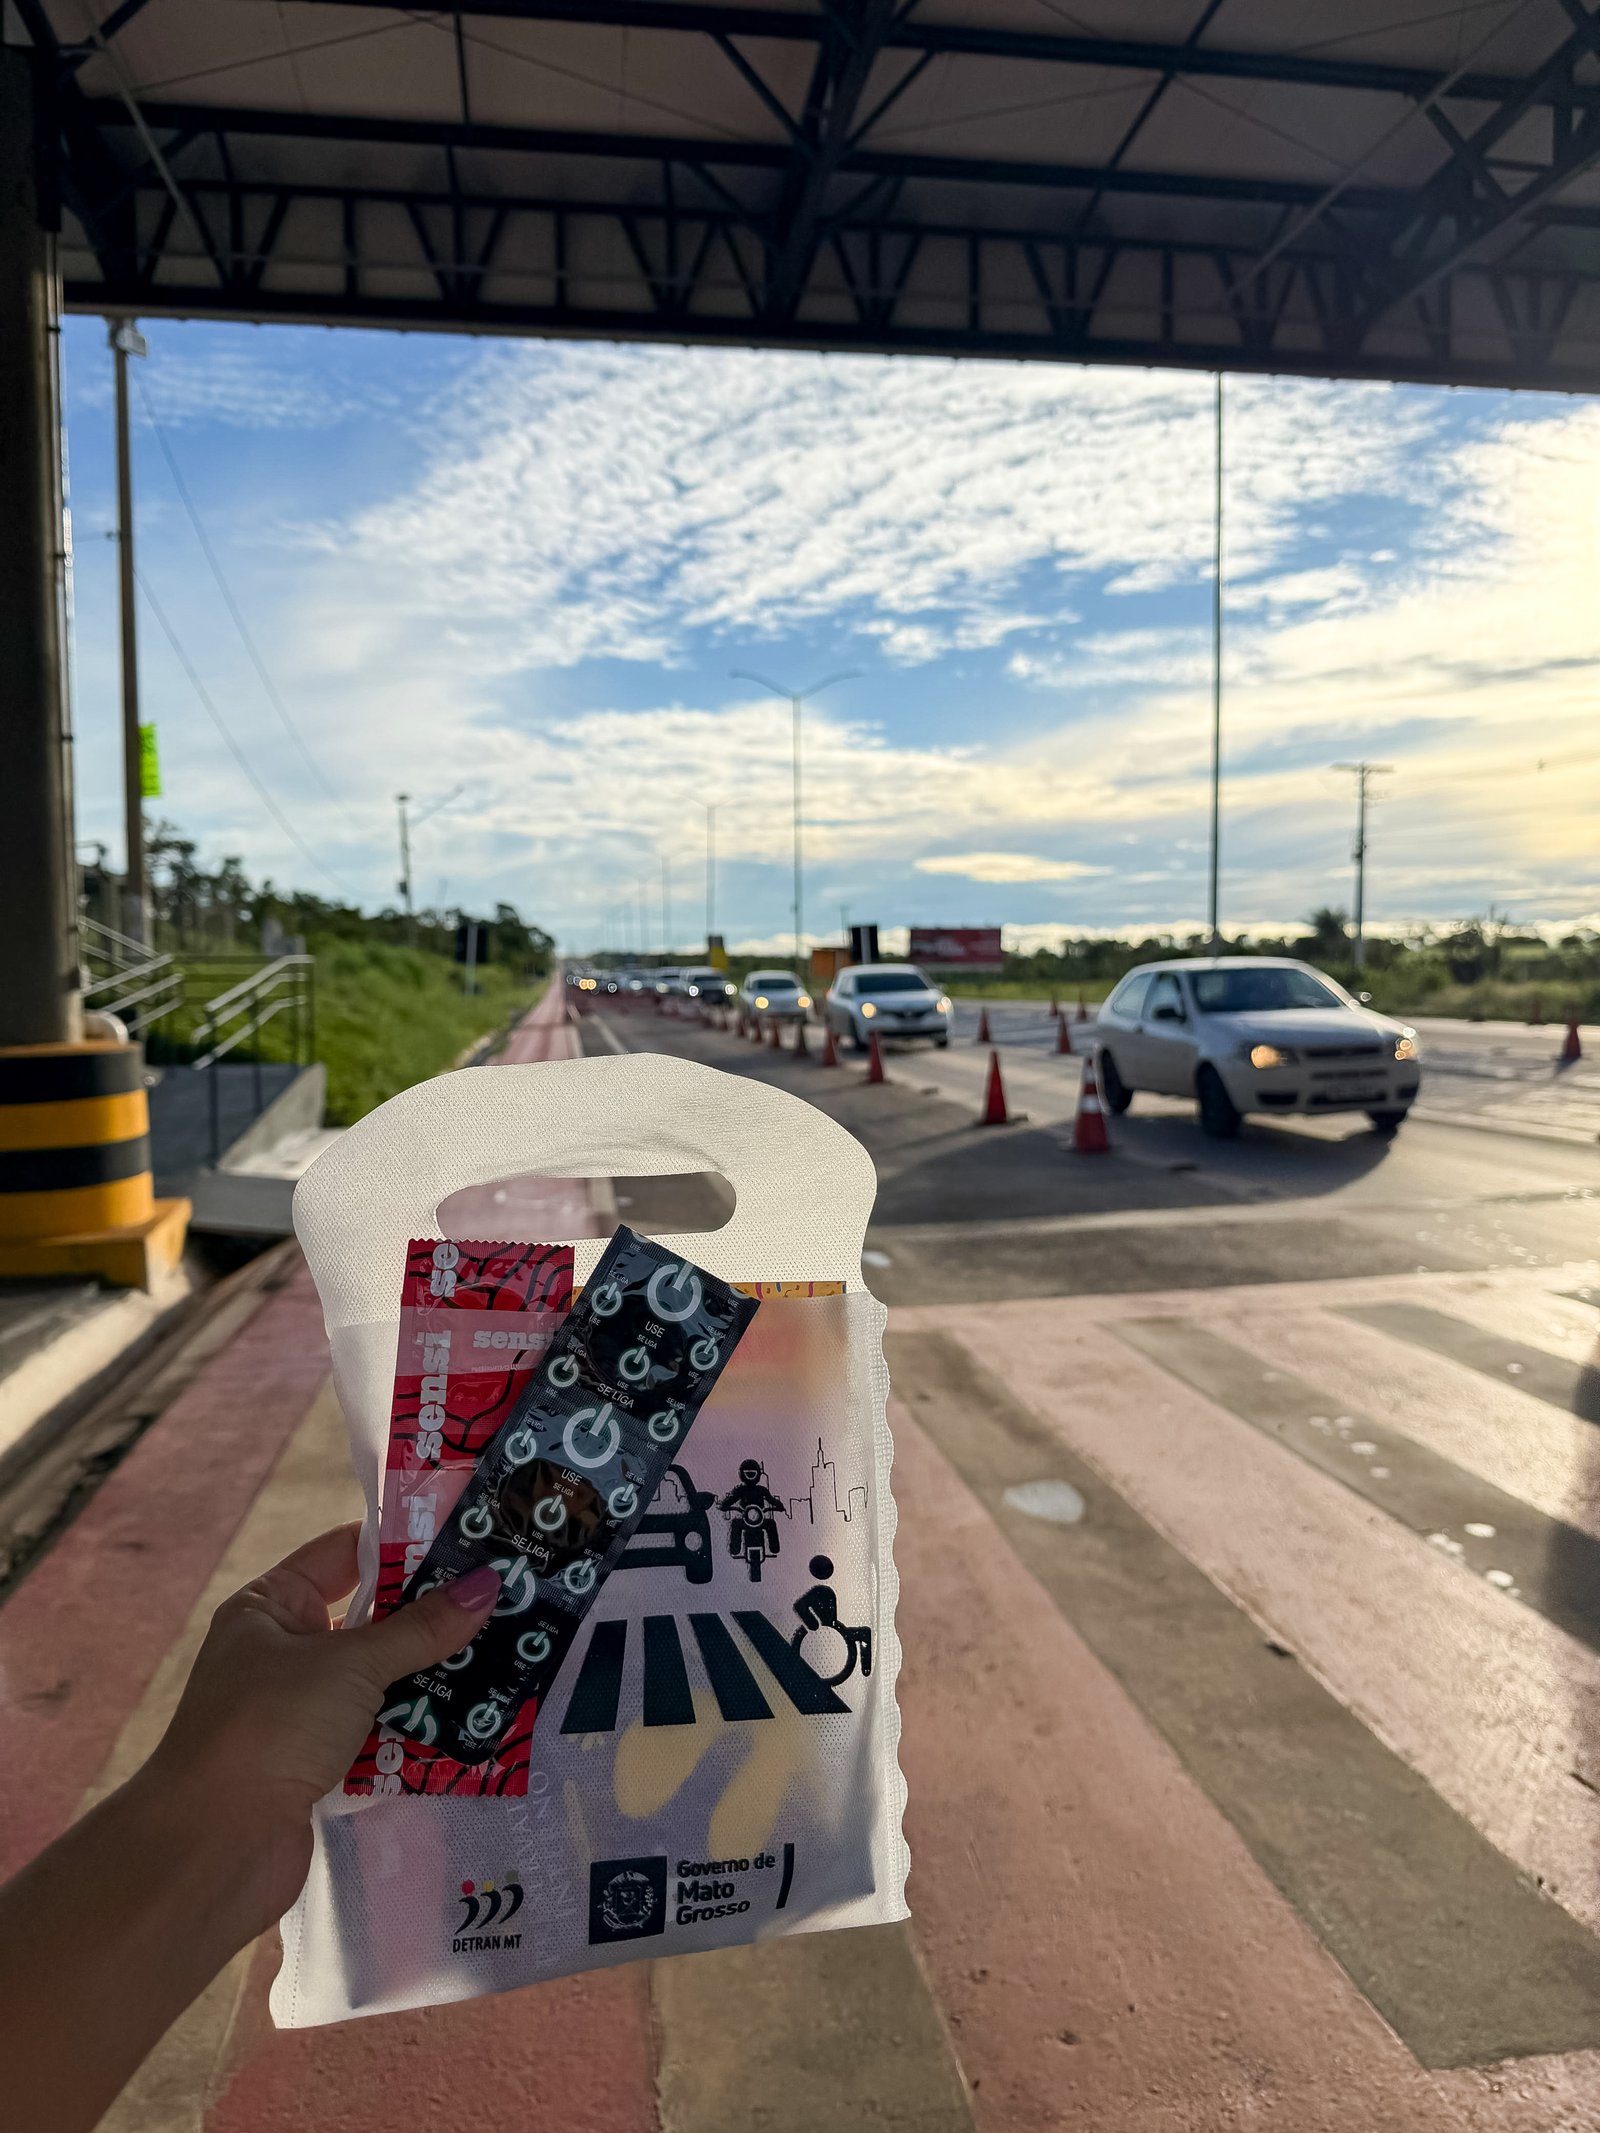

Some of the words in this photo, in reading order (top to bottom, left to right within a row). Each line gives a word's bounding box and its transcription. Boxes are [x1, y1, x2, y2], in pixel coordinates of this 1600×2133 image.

[617, 1274, 629, 1285] LIGA
[590, 1316, 601, 1325] USE
[645, 1321, 665, 1338] USE
[645, 1338, 658, 1349] LIGA
[574, 1346, 586, 1358] LIGA
[616, 1380, 628, 1390] USE
[416, 1330, 451, 1459] sensi
[545, 1388, 558, 1397] USE
[597, 1383, 612, 1396] SE
[612, 1390, 634, 1408] LIGA
[561, 1469, 582, 1486] USE
[561, 1486, 574, 1497] LIGA
[488, 1497, 500, 1509] LIGA
[532, 1530, 544, 1540] USE
[458, 1538, 471, 1548] USE
[512, 1534, 526, 1548] SE
[526, 1541, 550, 1560] LIGA
[546, 1624, 559, 1635] LIGA
[514, 1660, 526, 1670] USE
[435, 1670, 448, 1680] USE
[413, 1674, 430, 1688] SE
[428, 1680, 452, 1700] LIGA
[677, 1858, 749, 1878] Governo
[753, 1852, 776, 1870] de
[677, 1880, 735, 1904] Mato
[676, 1900, 751, 1925] Grosso
[453, 1936, 500, 1953] DETRAN
[503, 1934, 522, 1949] MT
